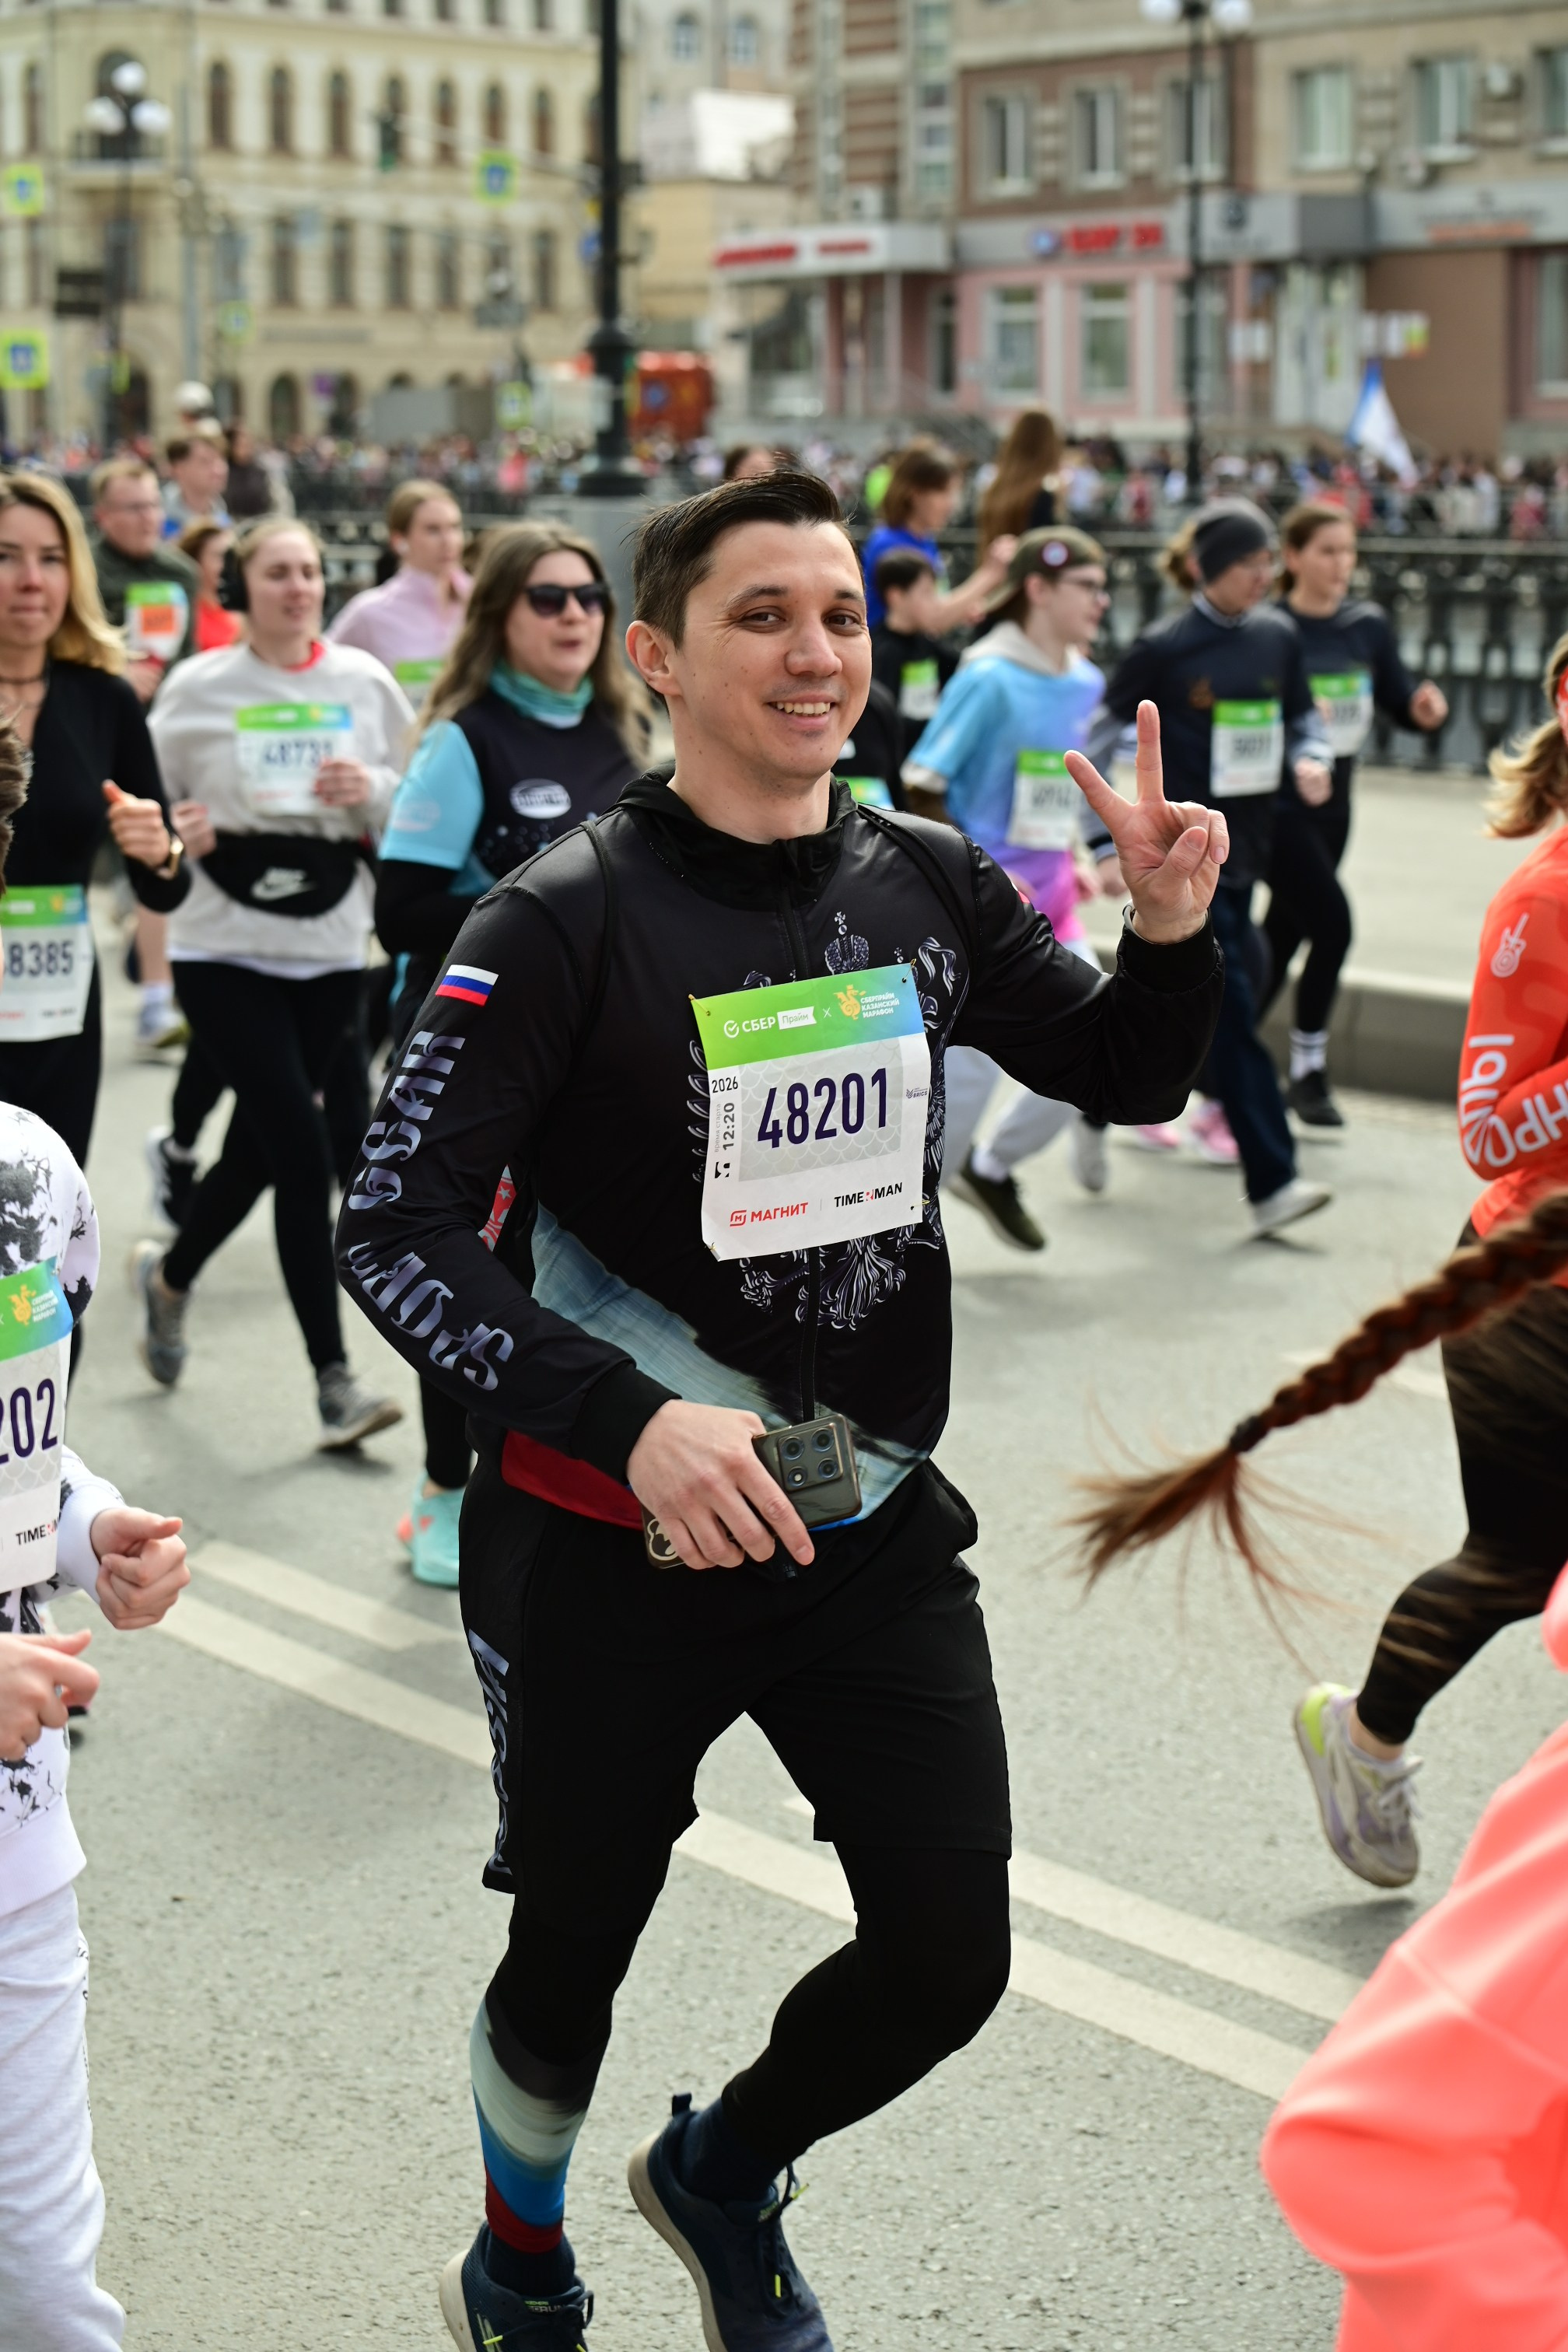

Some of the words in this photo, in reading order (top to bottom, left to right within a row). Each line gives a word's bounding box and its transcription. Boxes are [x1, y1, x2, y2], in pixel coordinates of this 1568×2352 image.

[862, 998, 900, 1011] КАЗАНСКИЙ
[863, 1008, 894, 1019] МАРАФОН
[741, 1016, 776, 1033] СБЕР
[782, 1012, 809, 1025] Прайм
[712, 1076, 739, 1094] 2026
[757, 1067, 887, 1150] 48201
[348, 1030, 467, 1211] GEAR
[723, 1102, 735, 1151] 12:20
[751, 1202, 809, 1223] МАГНИТ
